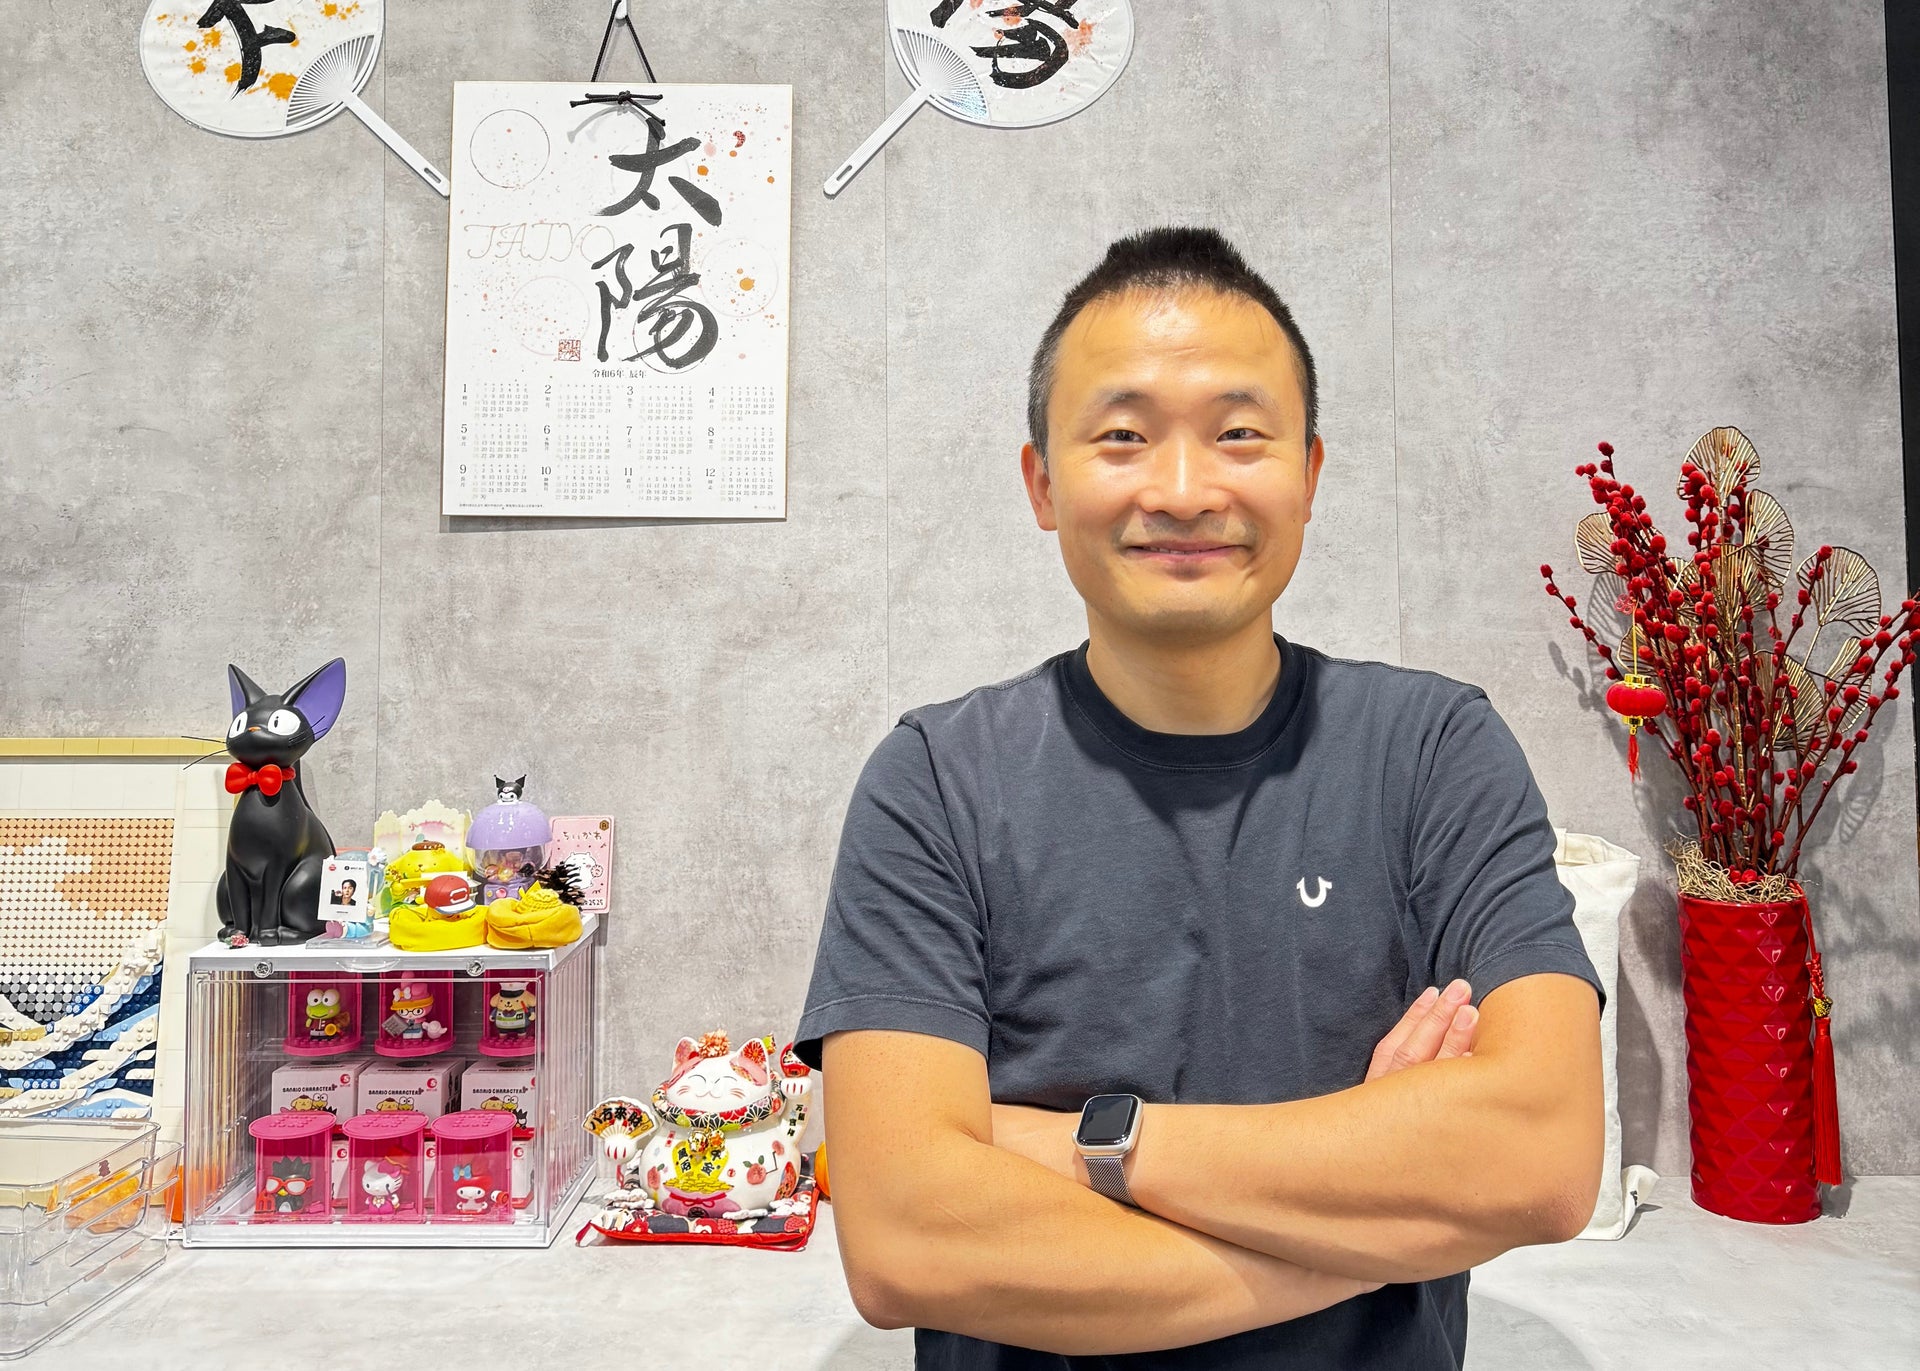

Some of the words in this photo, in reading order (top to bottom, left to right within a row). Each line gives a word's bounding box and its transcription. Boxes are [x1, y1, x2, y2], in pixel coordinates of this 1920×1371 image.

[463, 383, 467, 393] 1
[544, 385, 551, 394] 2
[627, 386, 634, 395] 3
[708, 387, 714, 396] 4
[461, 424, 467, 433] 5
[544, 425, 550, 434] 6
[626, 426, 632, 436] 7
[708, 427, 714, 436] 8
[460, 464, 466, 474] 9
[541, 466, 551, 475] 10
[624, 468, 632, 476] 11
